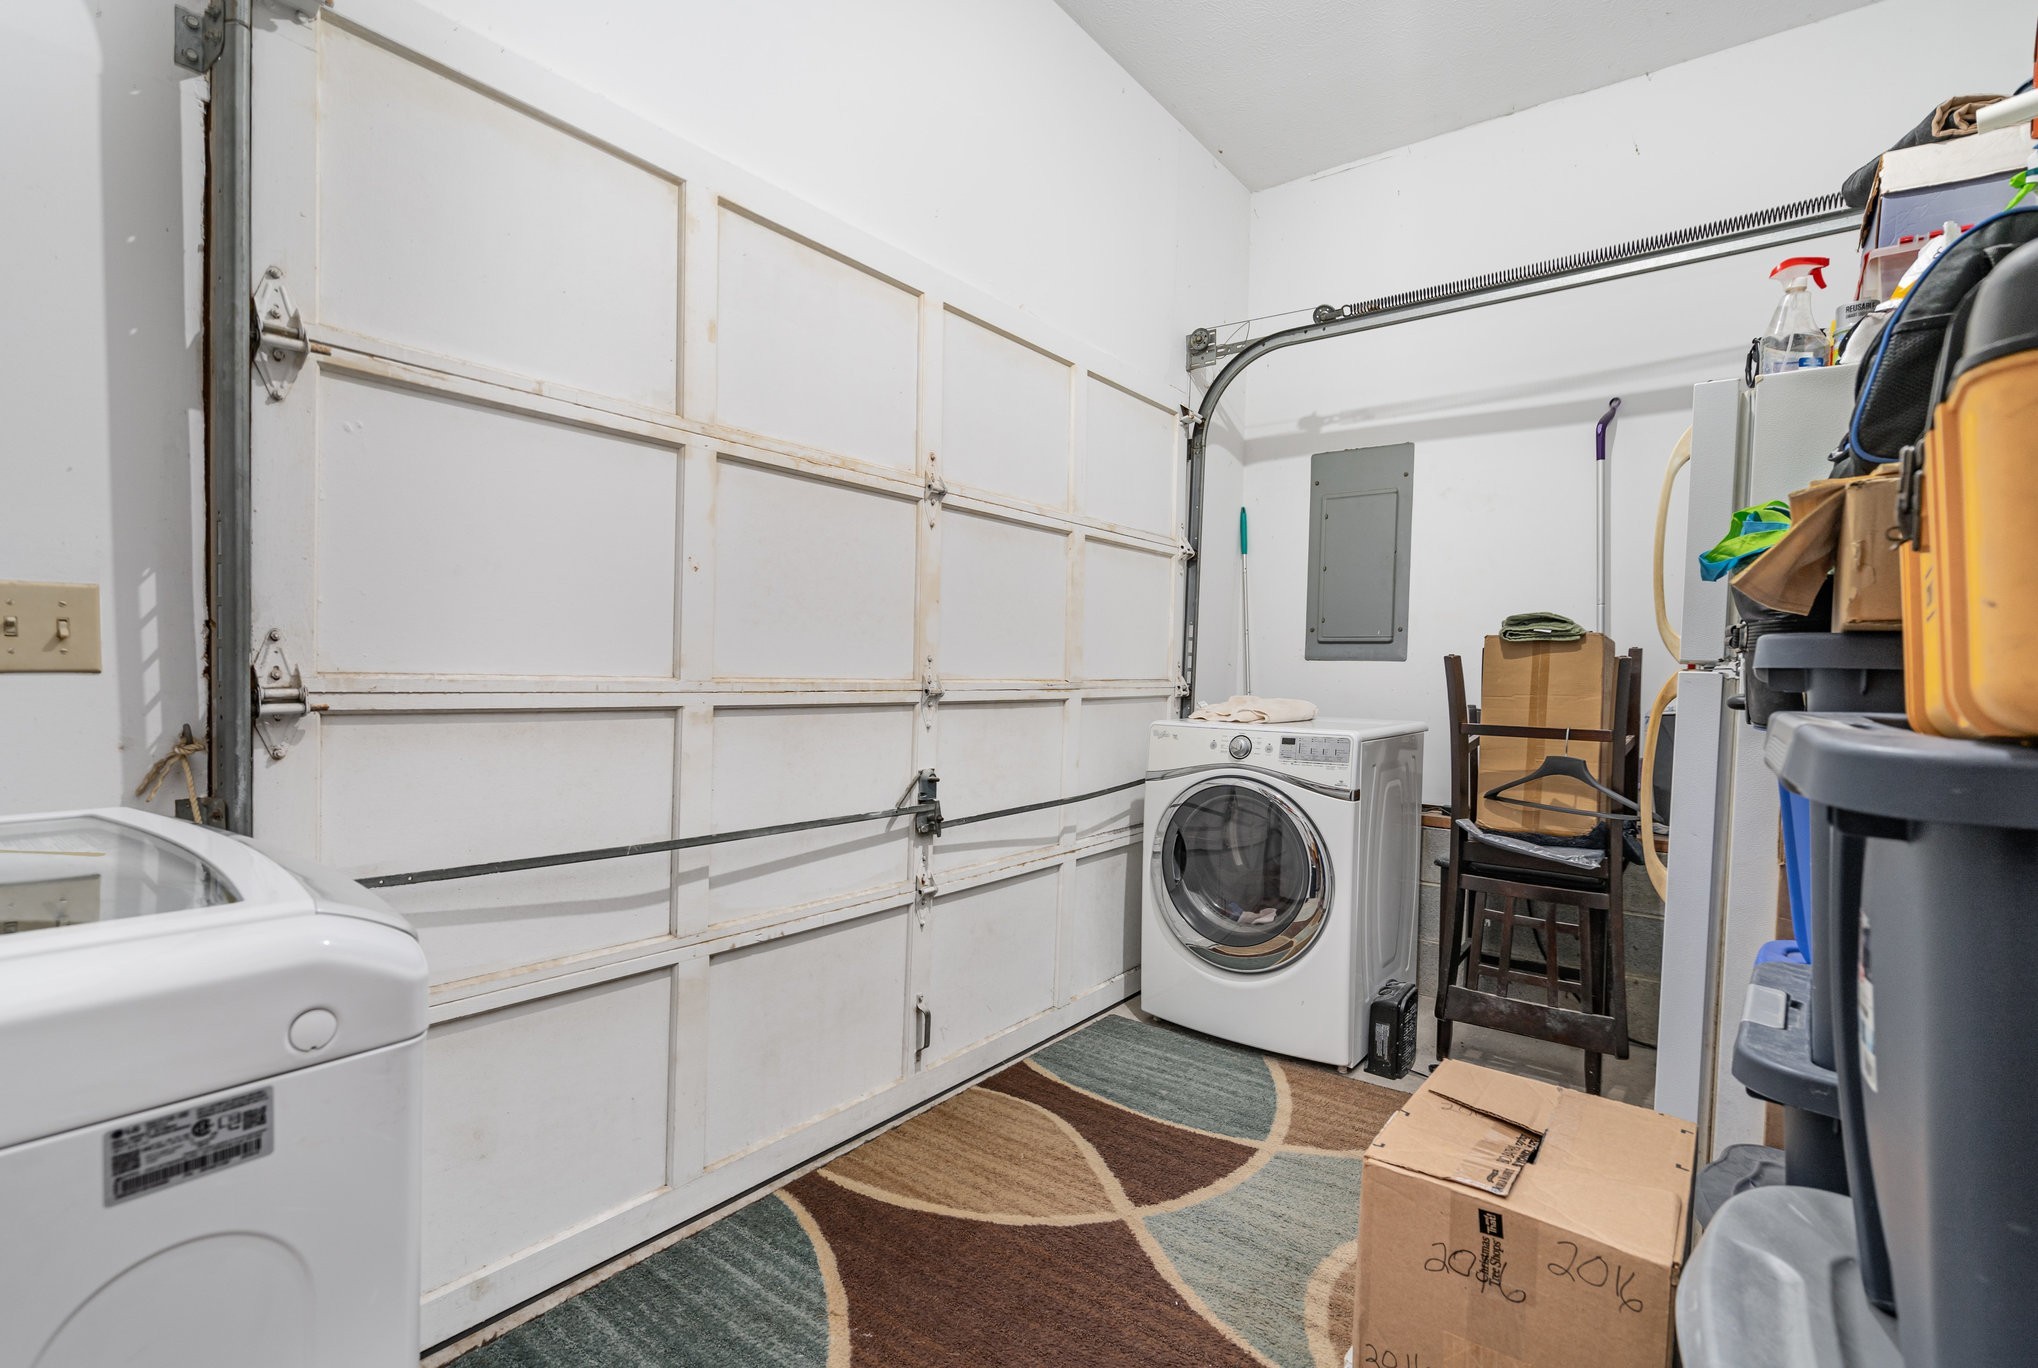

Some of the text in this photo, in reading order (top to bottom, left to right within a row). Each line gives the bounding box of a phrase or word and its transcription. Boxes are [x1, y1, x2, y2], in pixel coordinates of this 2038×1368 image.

[1475, 1235, 1490, 1283] Christmas
[1489, 1240, 1504, 1287] Tree Shops
[1547, 1240, 1644, 1313] 2016
